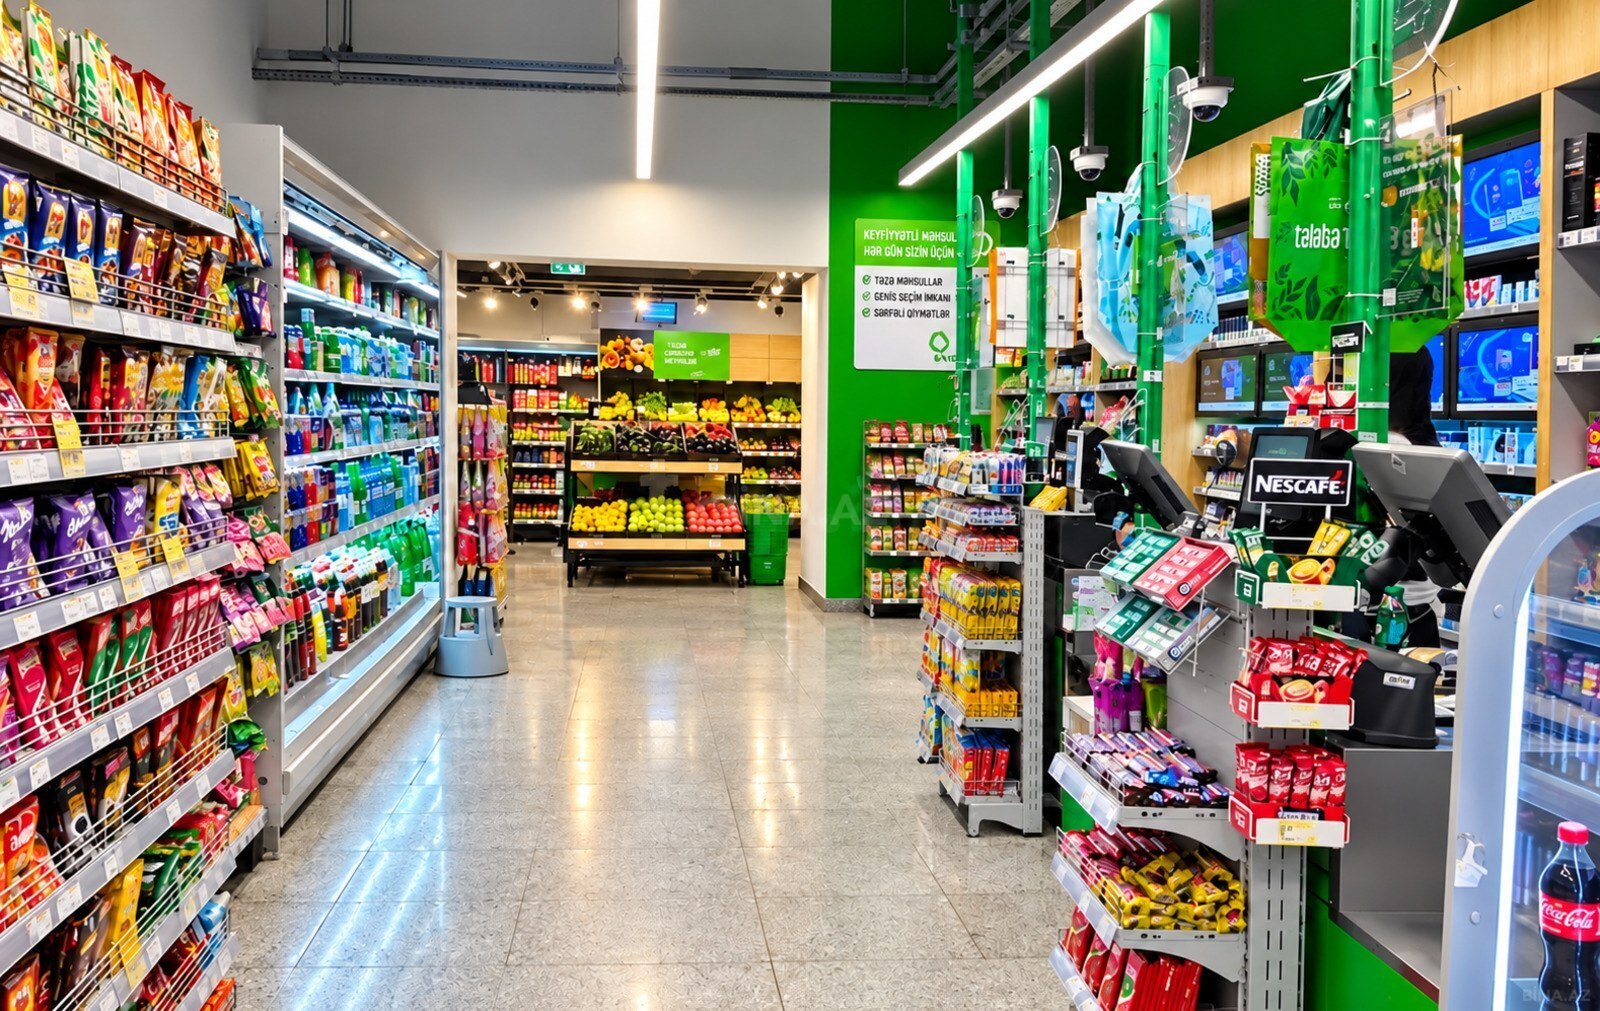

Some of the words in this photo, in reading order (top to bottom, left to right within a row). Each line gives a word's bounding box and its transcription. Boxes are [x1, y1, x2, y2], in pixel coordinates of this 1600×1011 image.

[863, 228, 919, 241] KEYFİYYƏTLİ
[864, 245, 882, 256] HƏR
[885, 244, 903, 257] GÜN
[905, 245, 928, 258] SİZİN
[930, 245, 954, 261] ÜÇÜN
[874, 276, 895, 286] TƏZƏ
[897, 277, 943, 287] MƏHSULLAR
[899, 291, 922, 303] SEÇİM
[874, 308, 905, 318] SƏRFƏLİ
[907, 308, 950, 319] QİYMƏTLƏR
